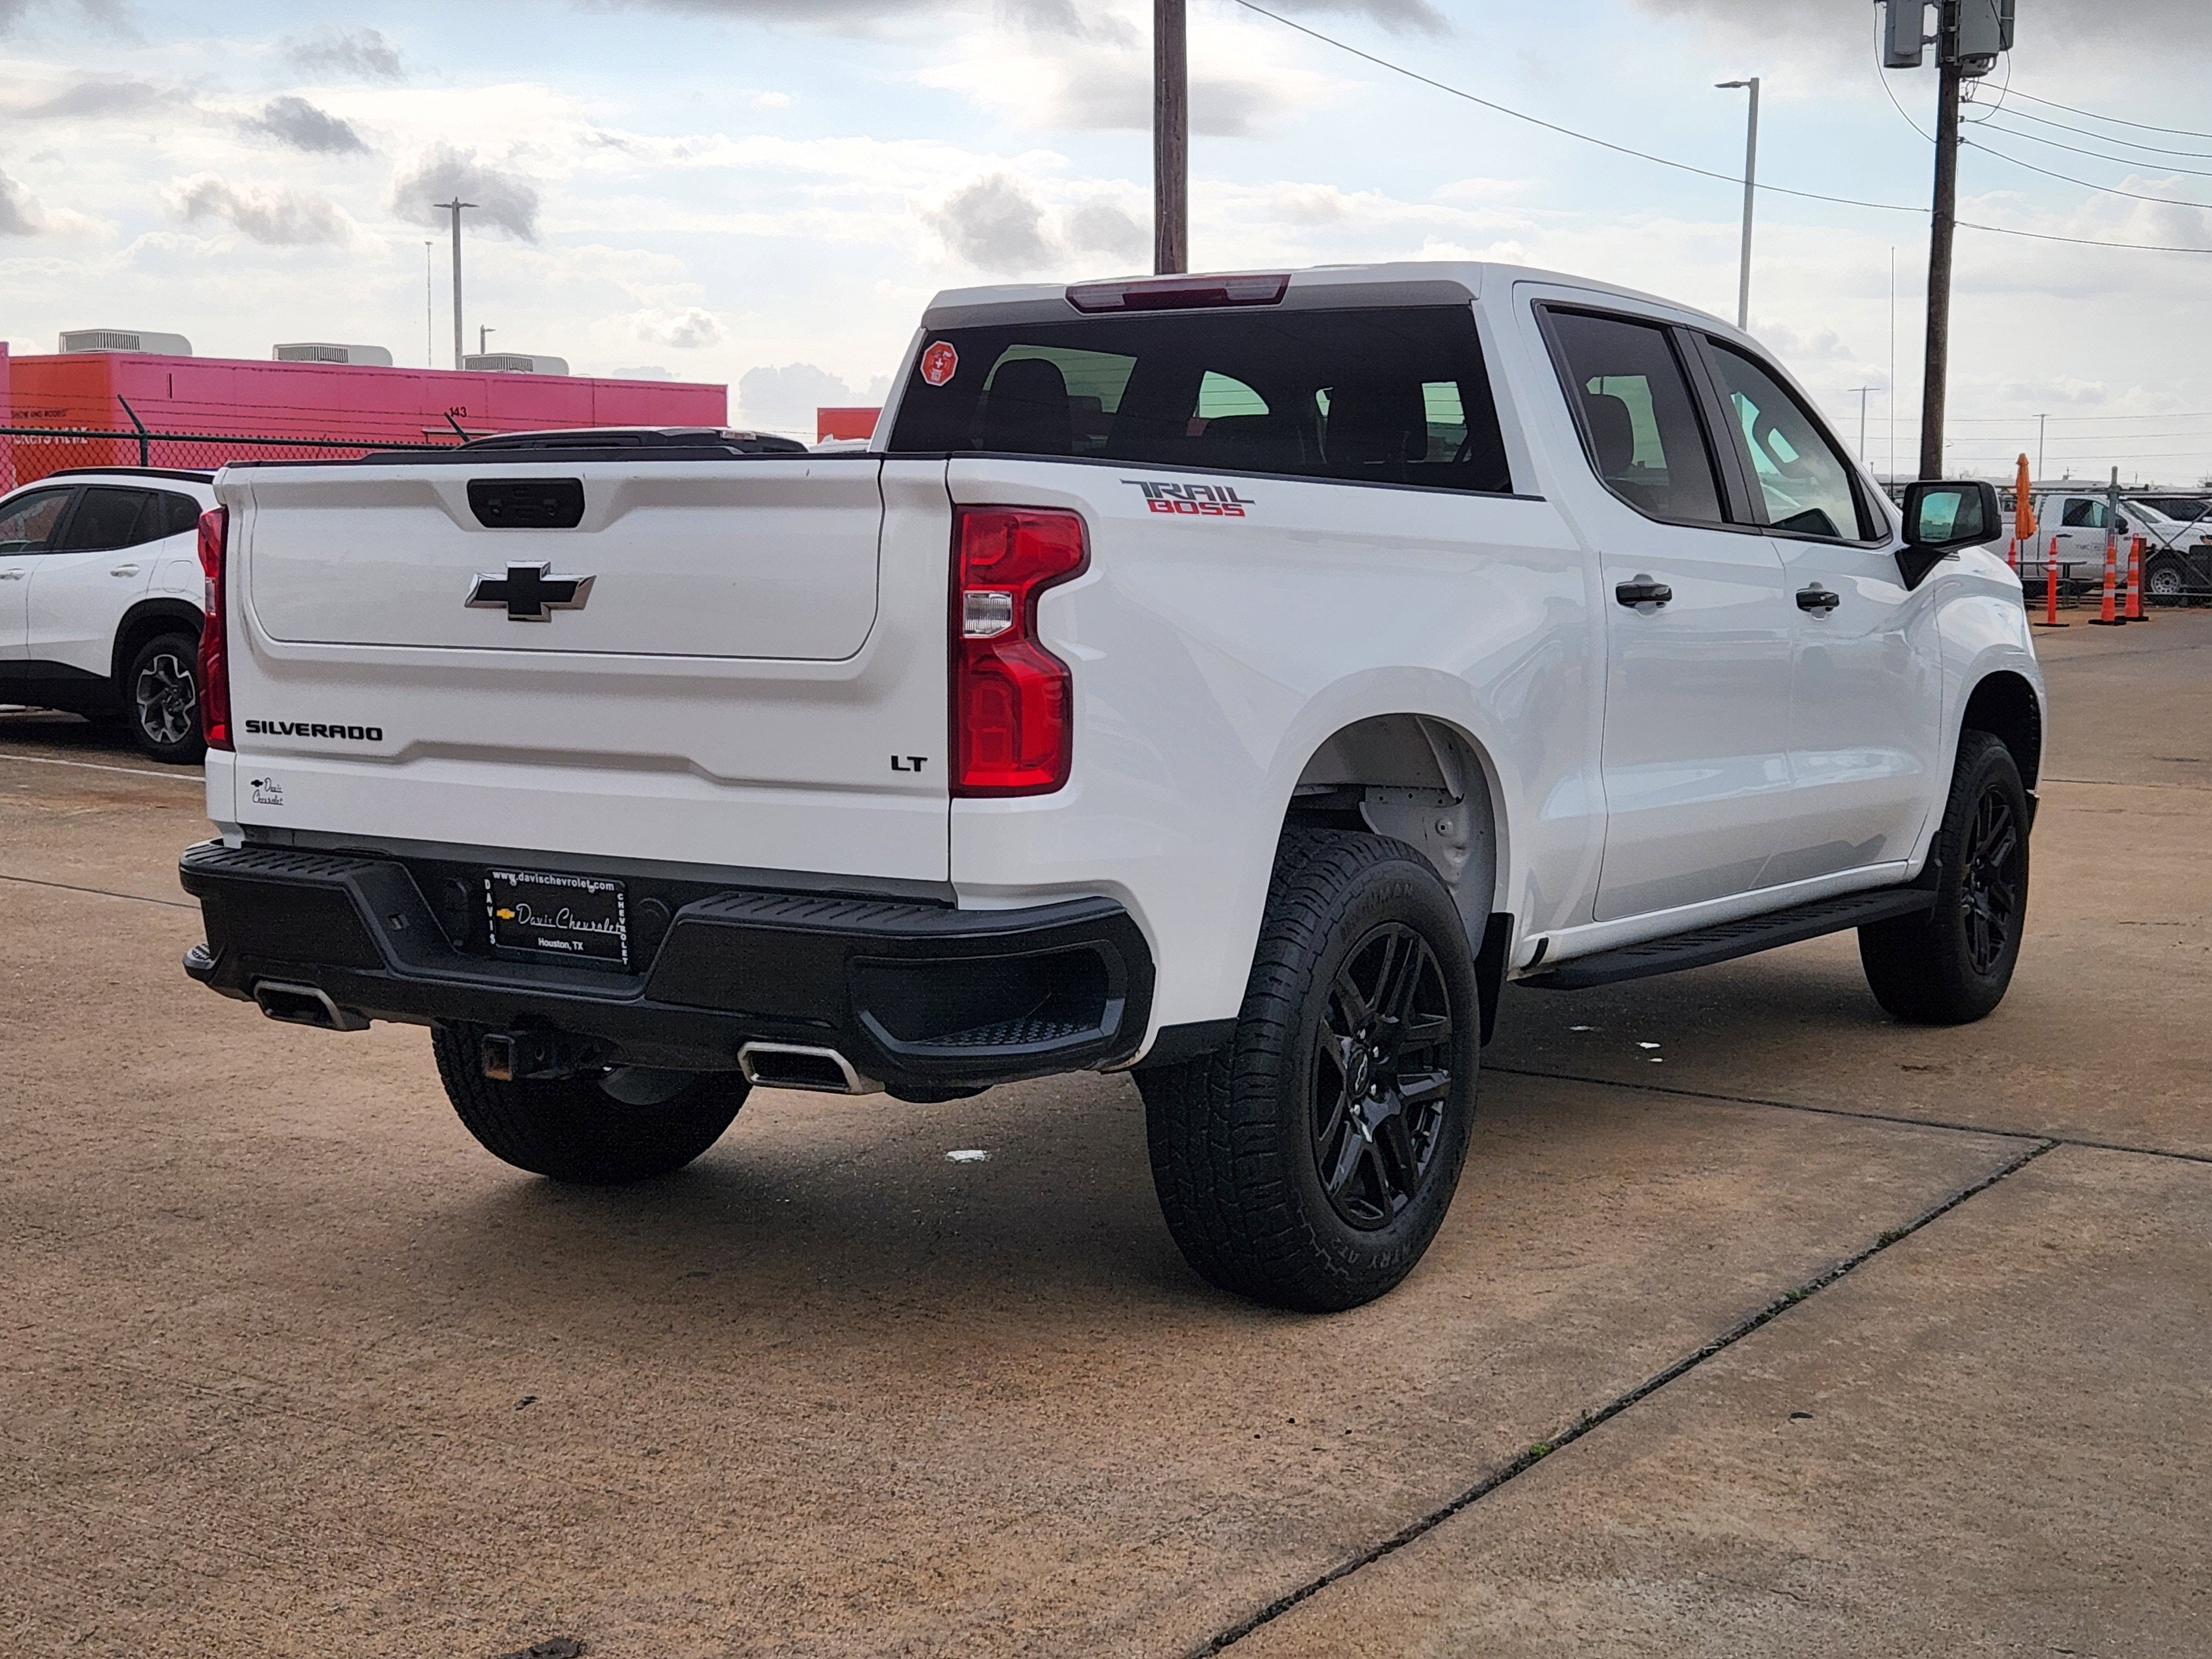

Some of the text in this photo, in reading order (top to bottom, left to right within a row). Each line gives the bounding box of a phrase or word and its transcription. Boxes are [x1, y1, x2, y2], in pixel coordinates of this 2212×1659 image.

[448, 406, 467, 418] 143
[1119, 478, 1256, 505] TRAIL
[1146, 498, 1245, 518] BOSS
[245, 719, 383, 742] SILVERADO
[891, 755, 928, 772] LT
[492, 871, 615, 891] www.davischevroletcom
[484, 879, 496, 945] DAVIS
[515, 903, 622, 935] Davis Chevrolet
[617, 893, 628, 965] CHEVROLET
[538, 937, 584, 951] Houston, TX
